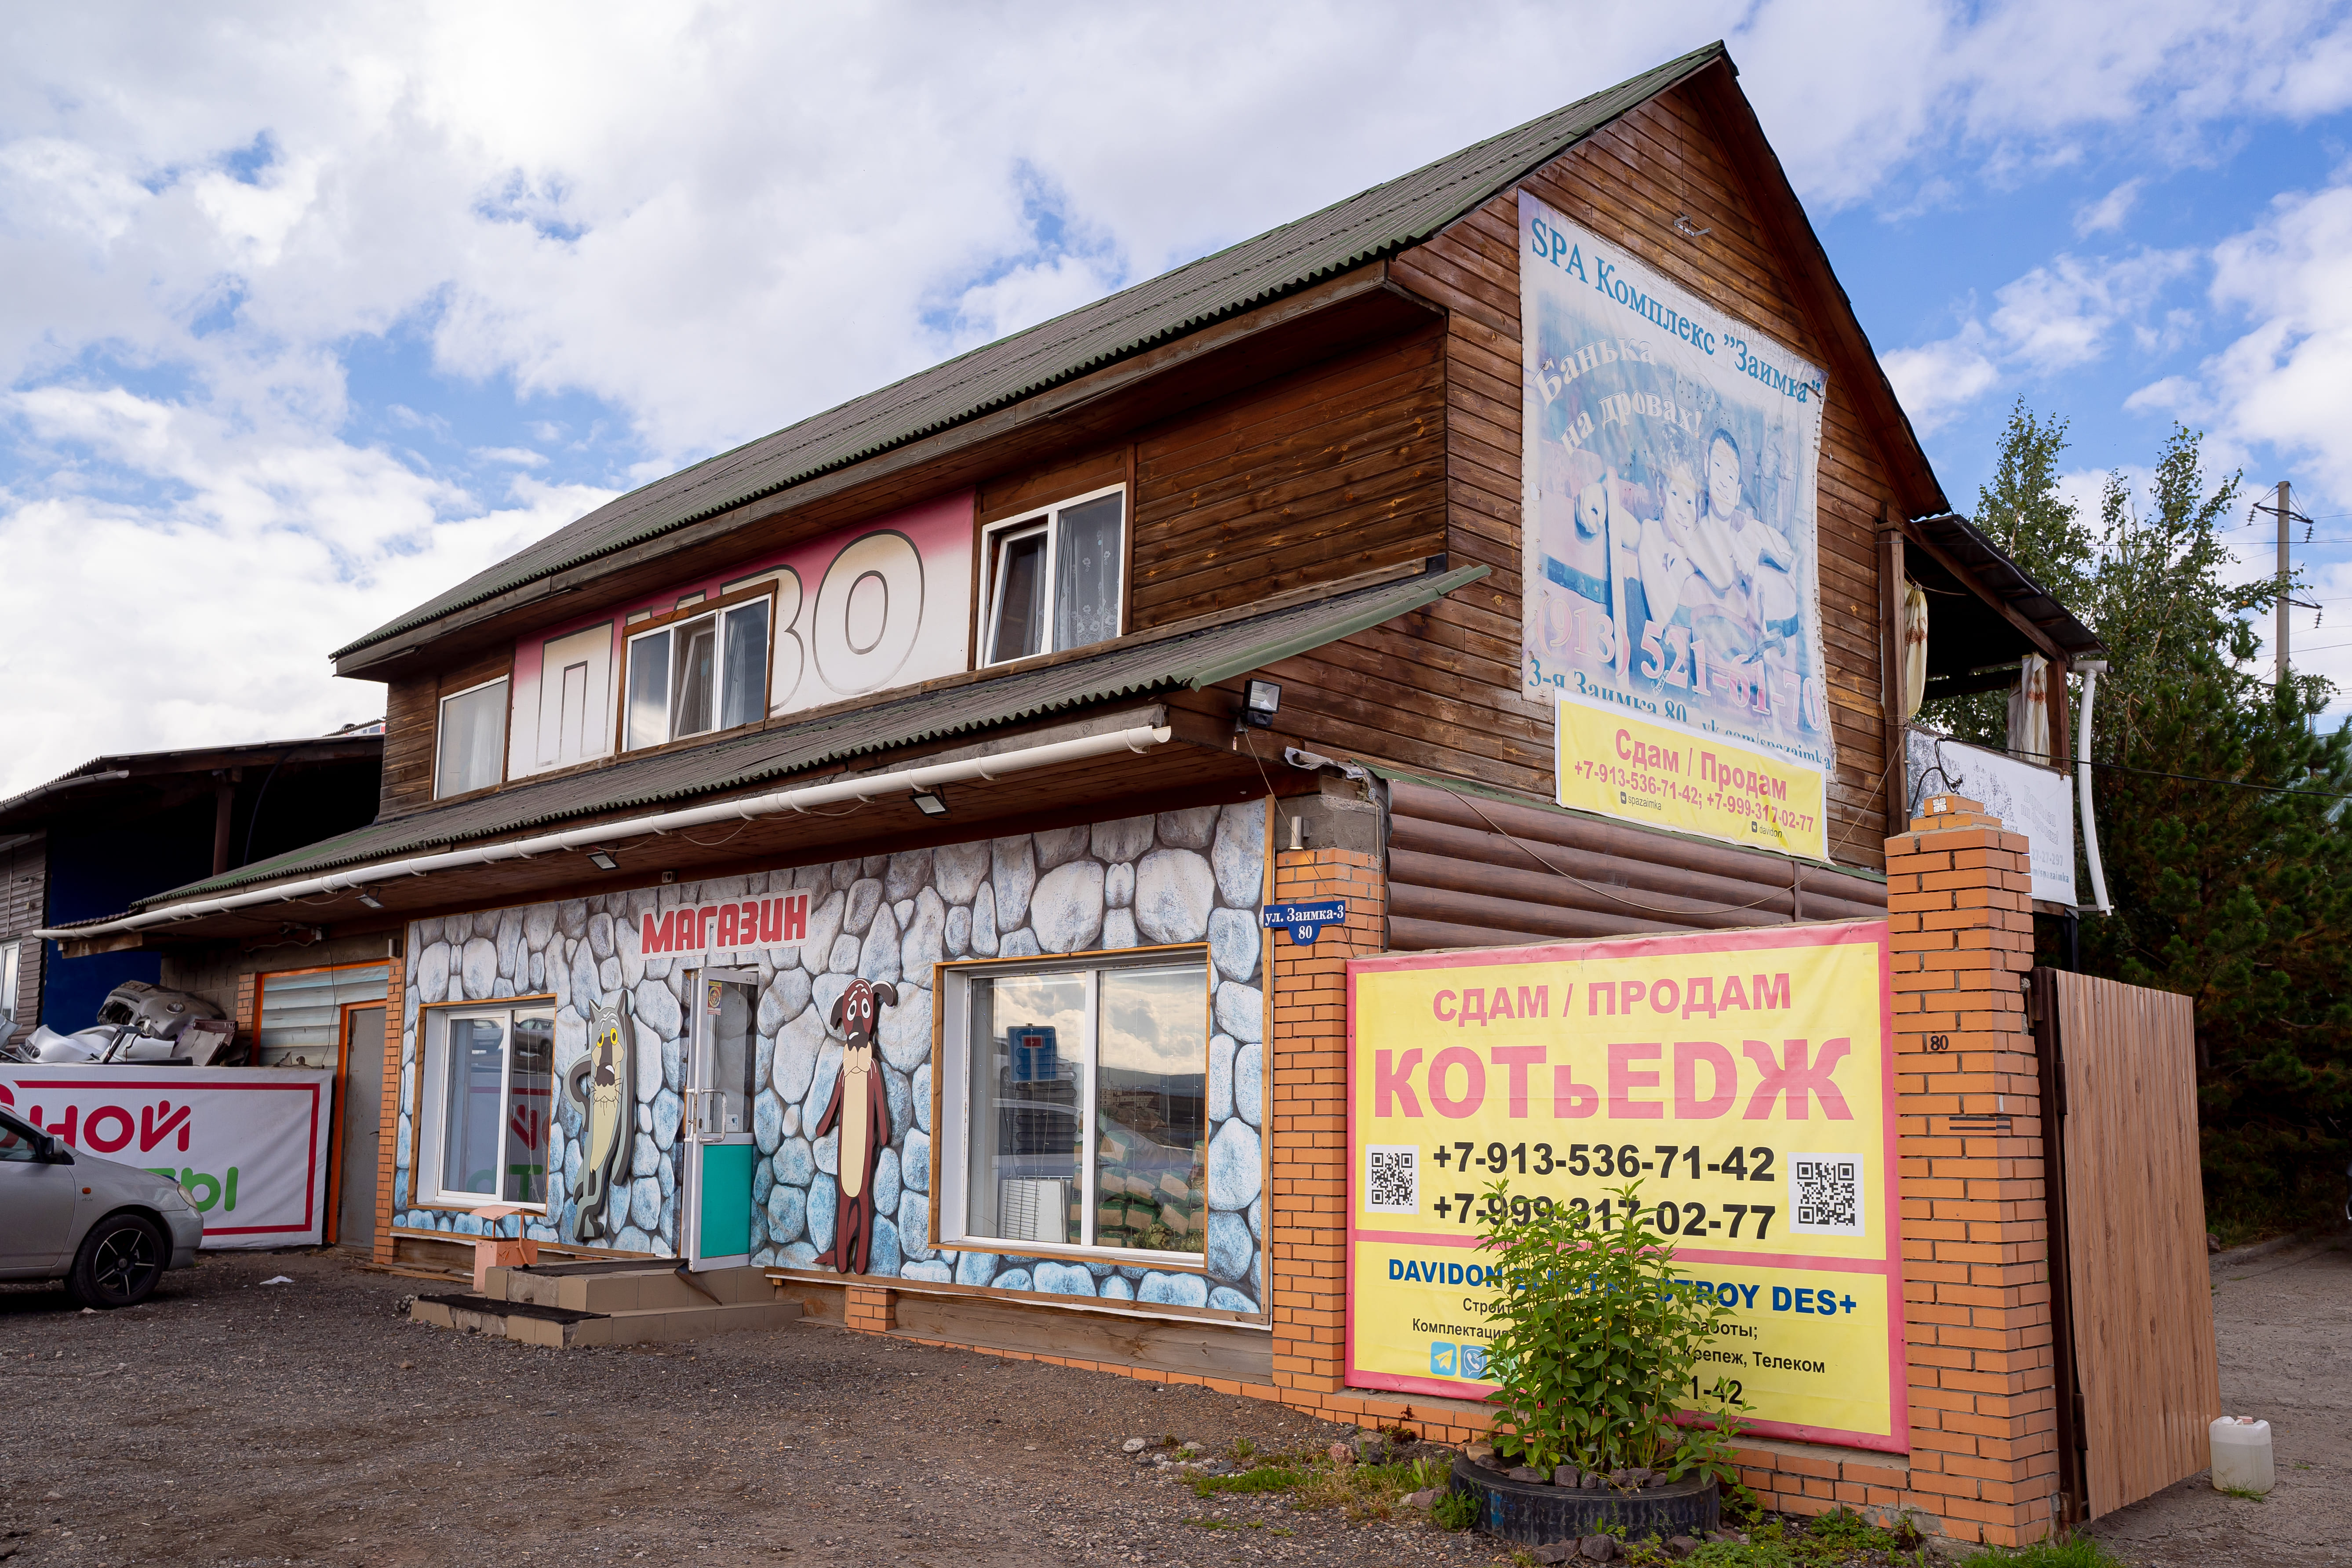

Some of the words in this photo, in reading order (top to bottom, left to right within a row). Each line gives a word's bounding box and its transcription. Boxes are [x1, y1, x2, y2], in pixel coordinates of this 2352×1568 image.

[1532, 218, 1588, 284] SPA
[1595, 256, 1715, 355] Комплекс
[1532, 338, 1657, 410] Банька
[1560, 411, 1595, 457] на
[1598, 390, 1702, 439] дровах!
[536, 529, 925, 768] ПВО
[1529, 659, 1565, 691] 3-я
[1536, 595, 1630, 678] (913)
[1641, 620, 1822, 731] 521-61-70
[1615, 729, 1679, 774] Сдам
[1687, 747, 1693, 777] /
[1701, 751, 1787, 801] Продам
[1574, 760, 1702, 810] +7-913-536-71-42;
[1707, 793, 1814, 833] +7-999-317-02-77
[1628, 795, 1661, 811] spazaimka
[1759, 824, 1783, 838] davidon
[641, 894, 808, 954] МАГАЗИН
[1265, 913, 1283, 926] ул.
[1286, 905, 1344, 922] Заимка-3
[1298, 925, 1312, 939] 80
[1433, 985, 1548, 1027] СДАМ
[1562, 983, 1573, 1017] /
[1588, 972, 1791, 1020] ПРОДАМ
[1930, 1035, 1949, 1051] 80
[1433, 1142, 1775, 1182] +7-913-536-71-42
[1389, 1259, 1503, 1288] DAVIDON
[1772, 1285, 1857, 1316] DES+
[1752, 1351, 1825, 1374] Телеком
